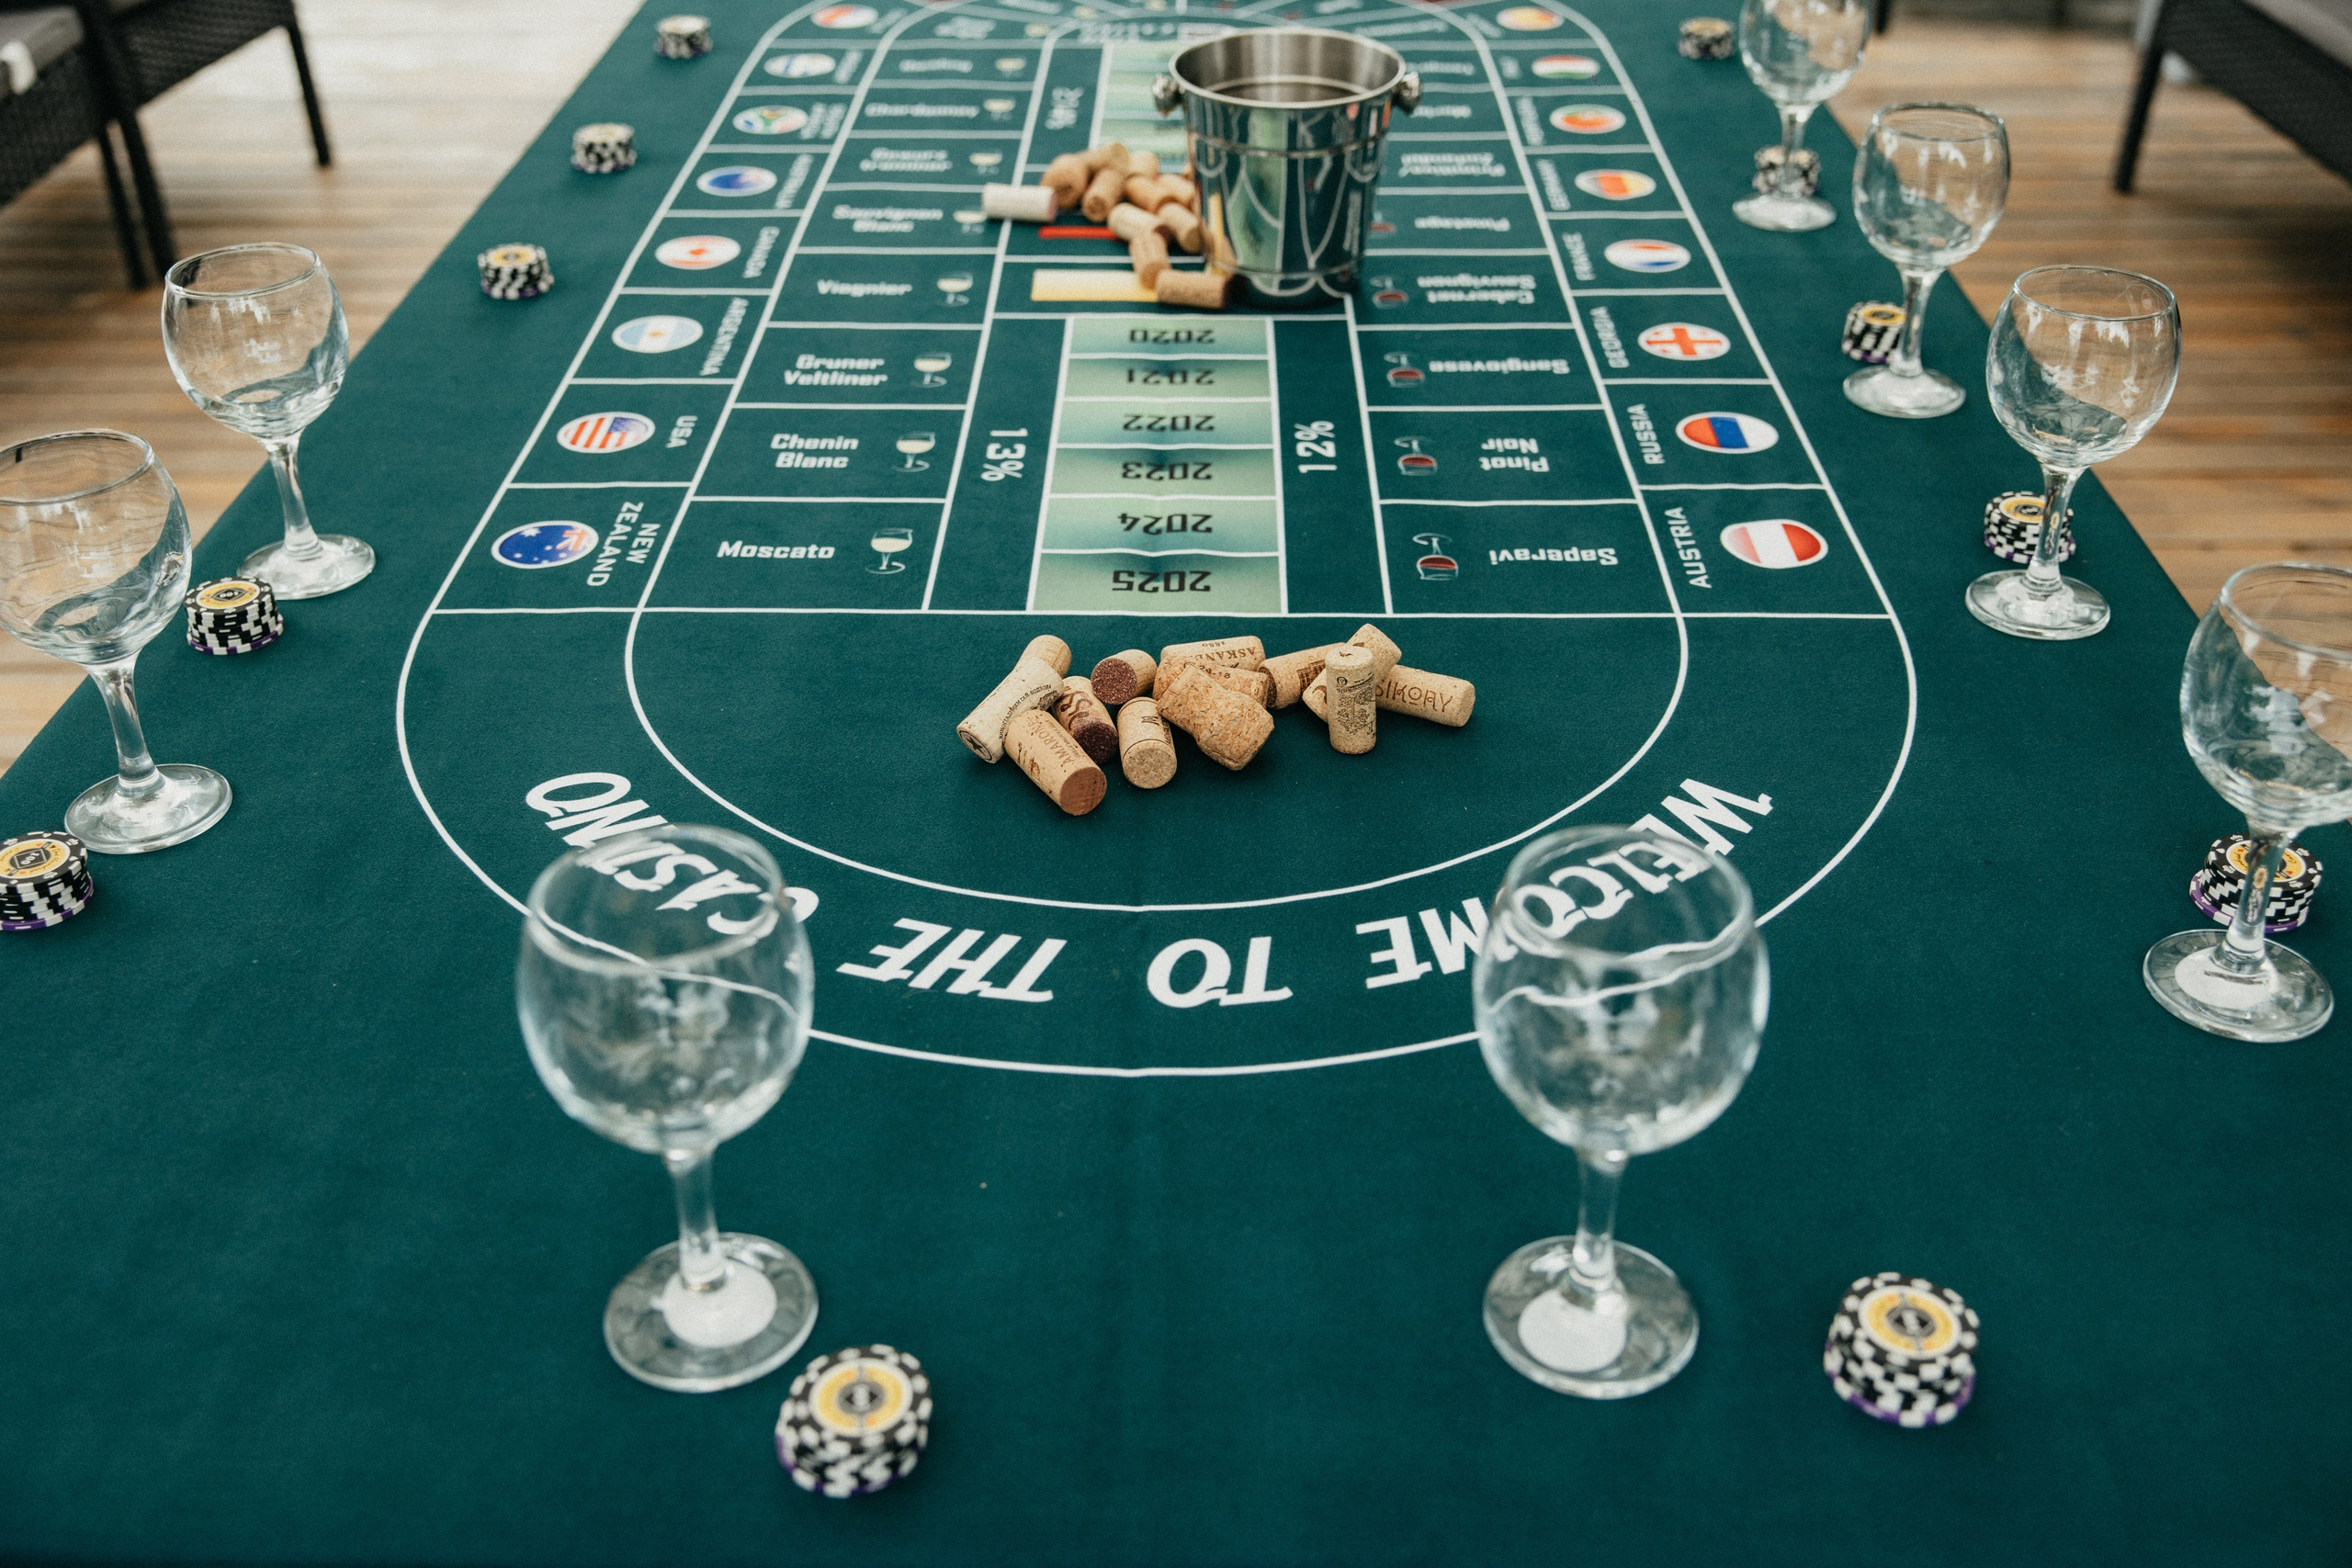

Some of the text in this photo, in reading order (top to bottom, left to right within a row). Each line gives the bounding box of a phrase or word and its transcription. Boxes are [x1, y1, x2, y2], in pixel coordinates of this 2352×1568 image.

[817, 280, 912, 298] Viognier
[1417, 273, 1536, 290] Sauvignon
[1426, 288, 1535, 305] Cabernet
[700, 298, 749, 377] ARGENTINA
[1129, 328, 1216, 345] 2020
[1589, 306, 1630, 368] GEORGIA
[797, 354, 885, 371] Gruner
[1429, 358, 1570, 375] Sangiovese
[784, 369, 888, 387] Veltliner
[1125, 368, 1216, 387] 2021
[666, 415, 698, 449] USA
[1123, 413, 1216, 433] 2022
[770, 434, 859, 451] Chenin
[1626, 403, 1666, 465] RUSSIA
[980, 428, 1028, 482] 13%
[1294, 420, 1338, 474] 12%
[1480, 437, 1539, 454] Noir
[775, 451, 849, 469] Blanc
[1479, 456, 1550, 473] Pinot
[1121, 461, 1214, 481] 2023
[1117, 512, 1214, 536] 2024
[586, 501, 644, 587] ZEALAND
[630, 523, 661, 565] NEW
[717, 540, 835, 559] Moscato
[1664, 506, 1712, 589] AUSTRIA
[1488, 547, 1619, 567] Saperavi
[1112, 570, 1212, 593] 2025
[20, 852, 40, 865] 100
[525, 772, 1773, 1010] WELCOME TO THE CASINO
